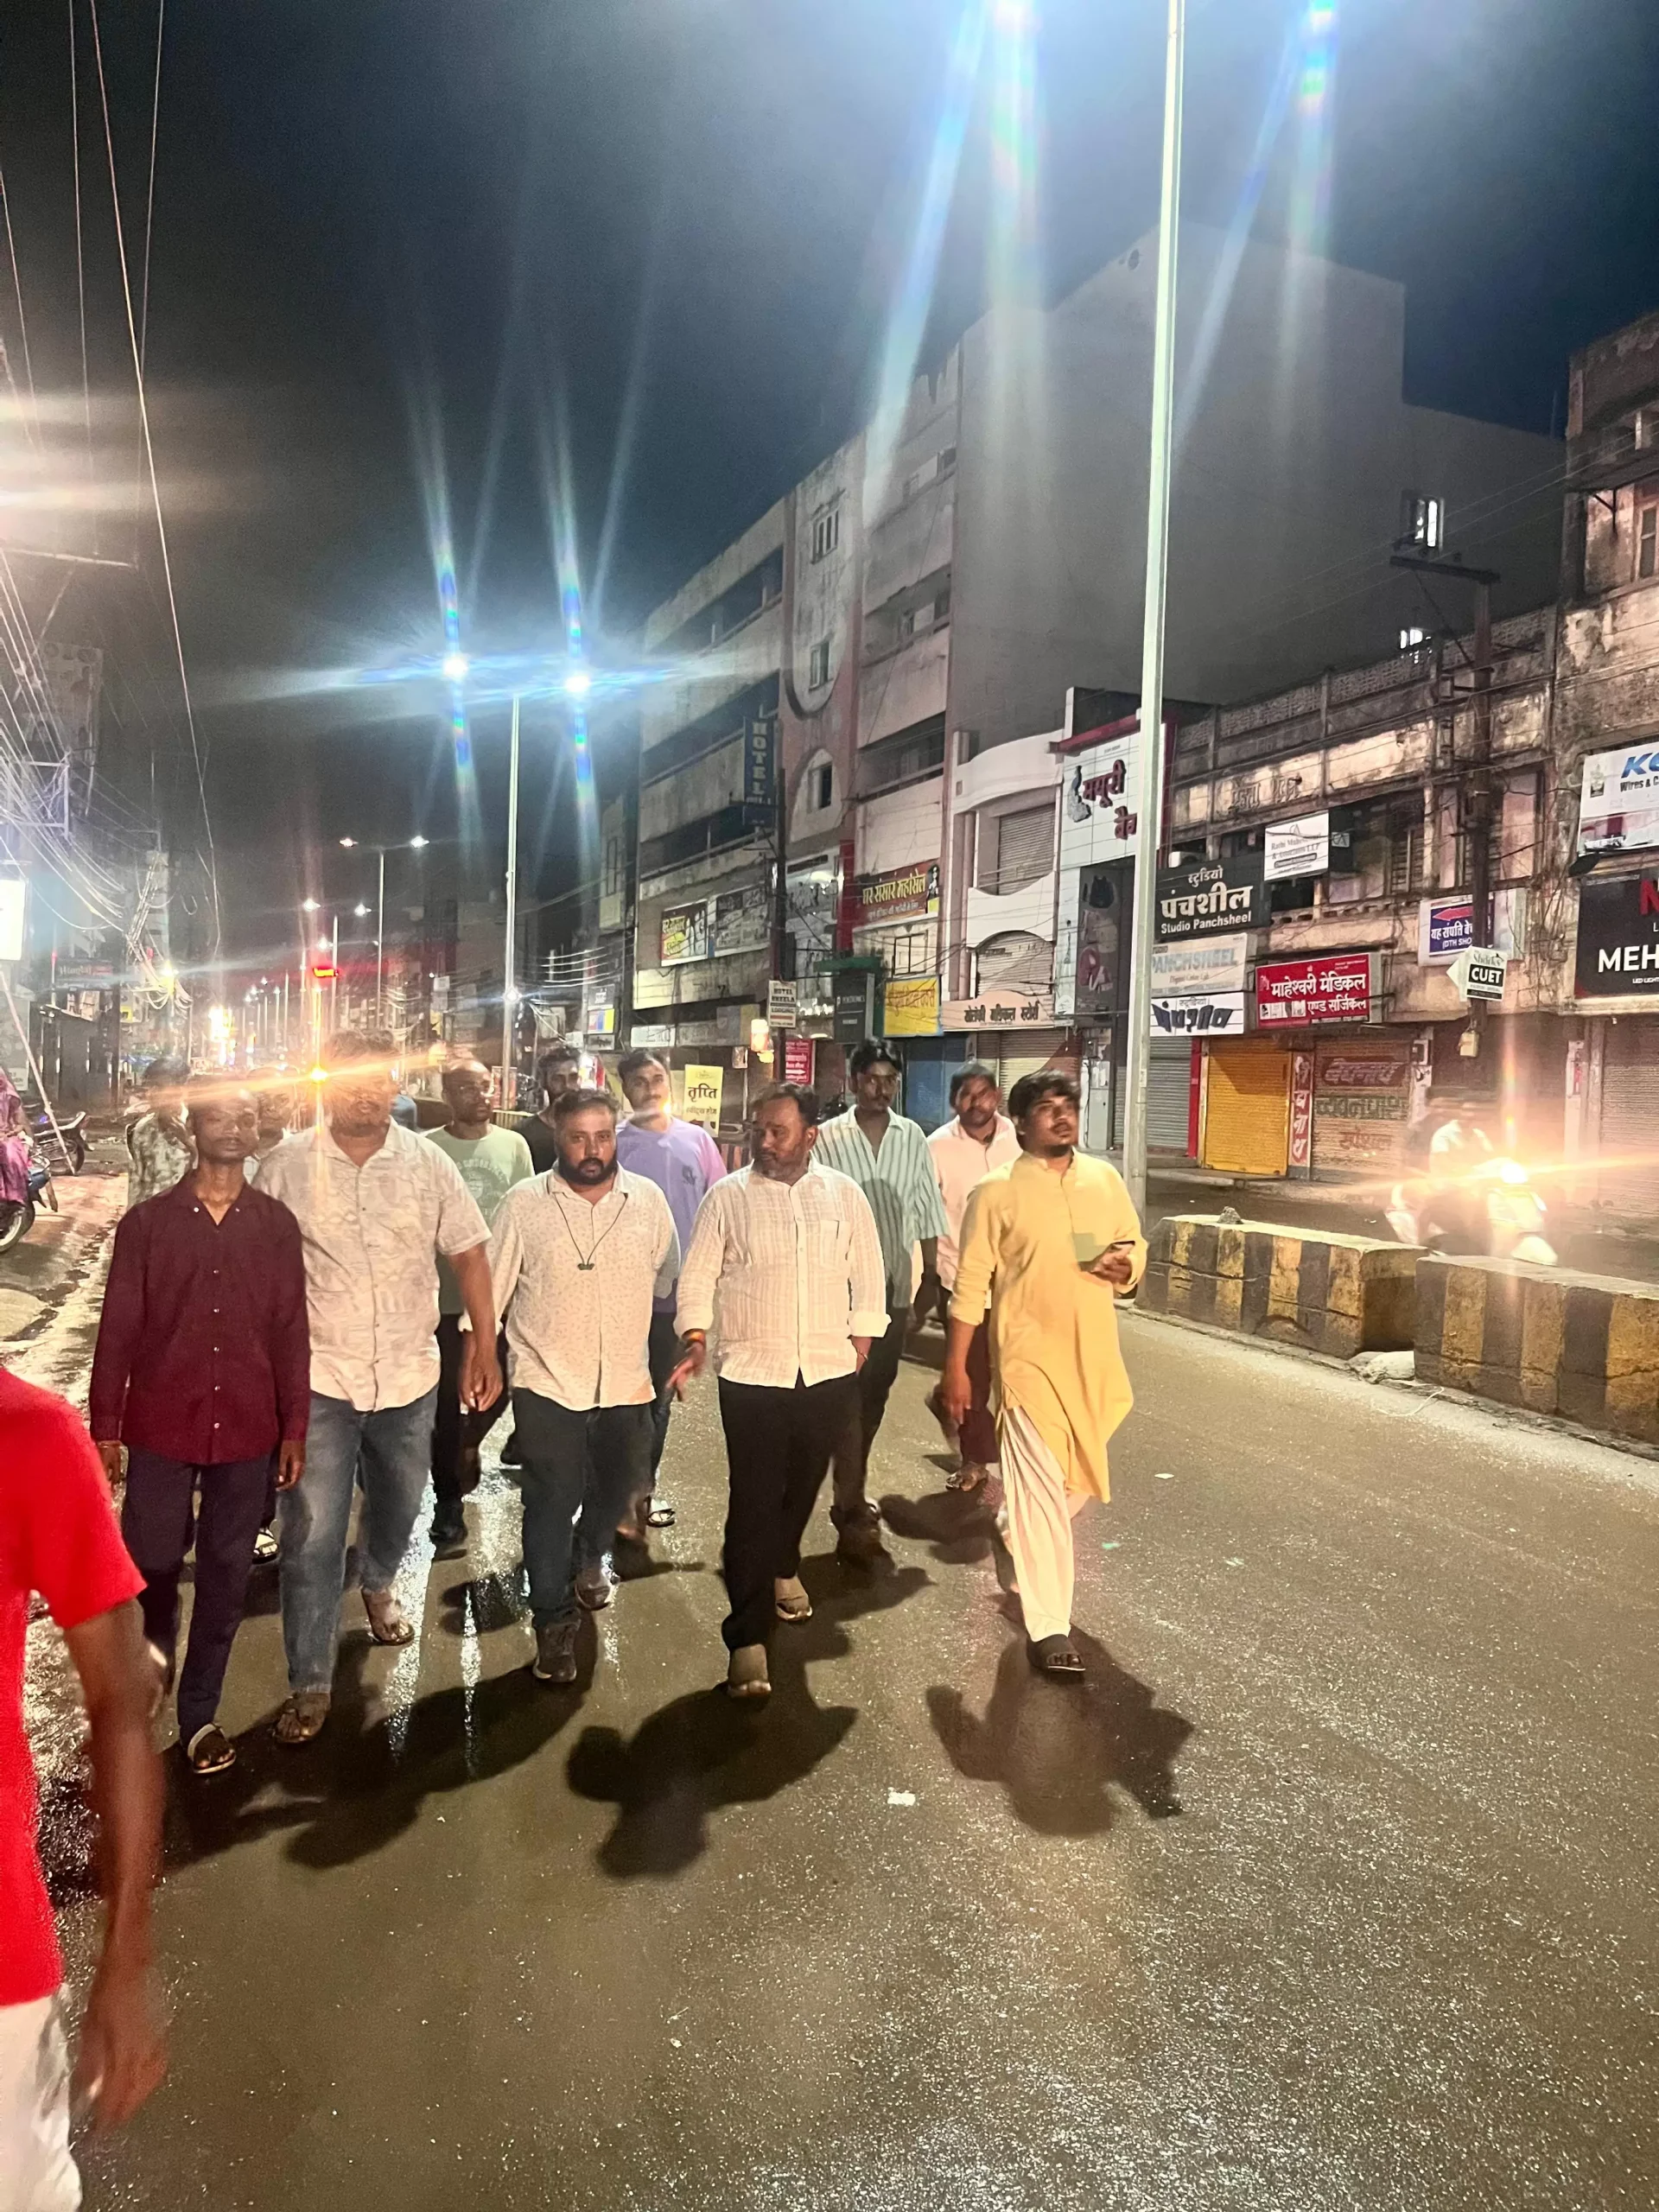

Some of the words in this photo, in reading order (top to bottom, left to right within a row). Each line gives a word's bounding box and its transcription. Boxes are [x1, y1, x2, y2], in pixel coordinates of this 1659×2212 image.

[752, 722, 767, 795] HOTEL
[1083, 760, 1126, 808] मयूरी
[1620, 779, 1644, 792] Wires
[1644, 778, 1651, 788] &
[1188, 865, 1224, 887] स्टुडियो
[1160, 881, 1254, 918] पंचशील
[1161, 919, 1191, 934] Studio
[1193, 910, 1252, 930] Panchsheel
[1431, 927, 1443, 940] यह
[1271, 973, 1317, 999] माहेश्वरी
[1319, 970, 1366, 993] मेडिकल
[1471, 967, 1502, 984] CUET
[1328, 994, 1366, 1012] सर्जिकल
[688, 1083, 718, 1103] तृप्ति
